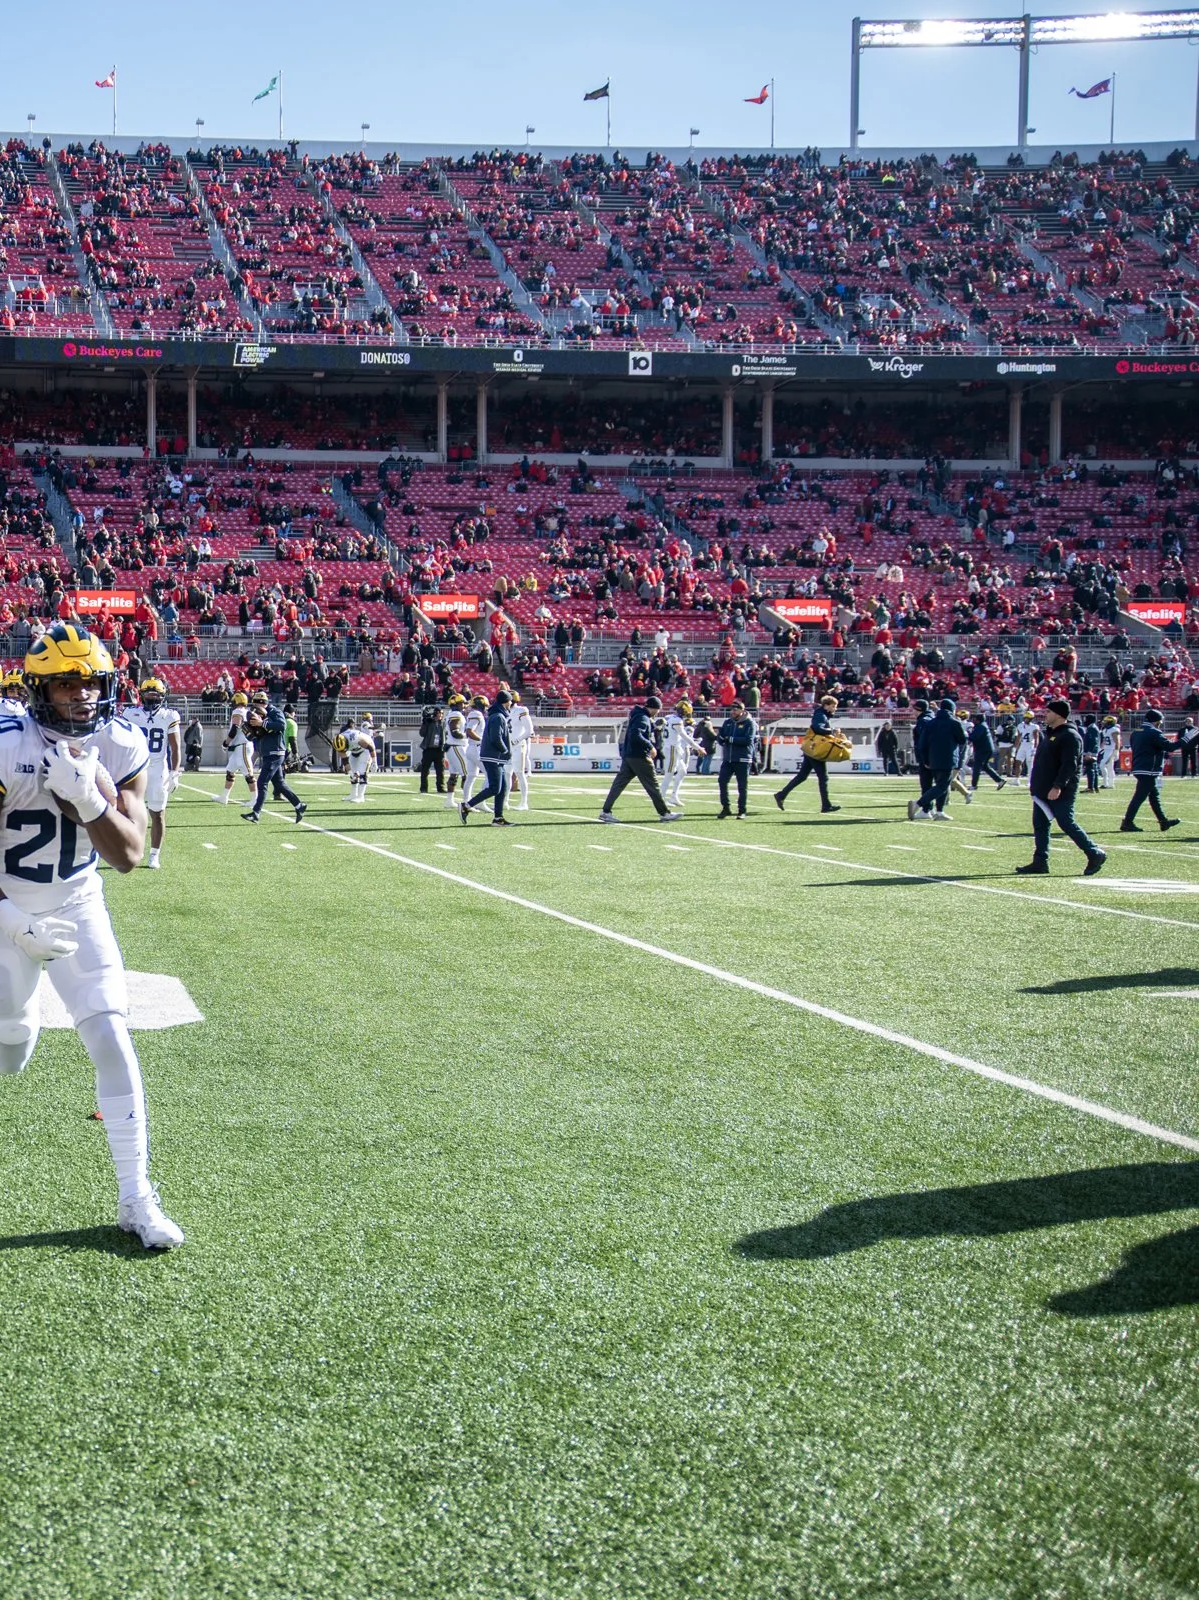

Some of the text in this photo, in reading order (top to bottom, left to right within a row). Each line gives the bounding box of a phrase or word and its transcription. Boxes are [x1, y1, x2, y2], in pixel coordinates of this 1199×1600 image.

[79, 345, 162, 359] Buckeyes Care
[632, 356, 650, 370] 10
[742, 355, 787, 364] The James
[885, 356, 924, 378] Kroger
[1009, 362, 1056, 374] Huntington
[1132, 361, 1187, 374] Buckeyes
[422, 601, 476, 612] Safelite
[776, 605, 829, 616] Safelite
[140, 727, 164, 753] 8
